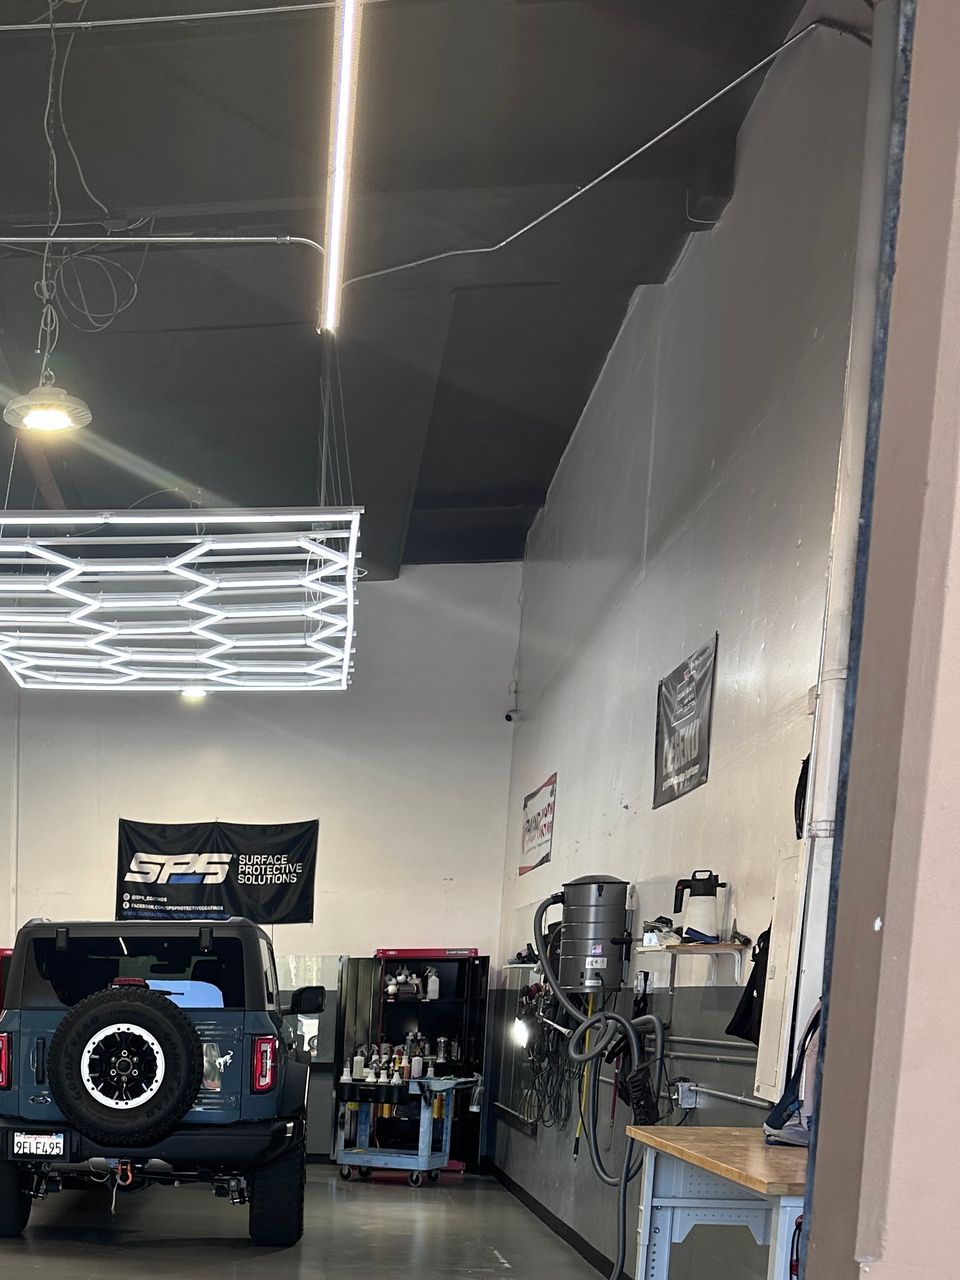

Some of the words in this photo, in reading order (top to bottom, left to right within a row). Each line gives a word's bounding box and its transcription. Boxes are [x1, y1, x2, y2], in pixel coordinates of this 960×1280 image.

[238, 854, 288, 864] SURFACE
[124, 852, 232, 884] SPS
[238, 863, 303, 875] PROTECTIVE
[237, 873, 297, 885] SOLUTIONS
